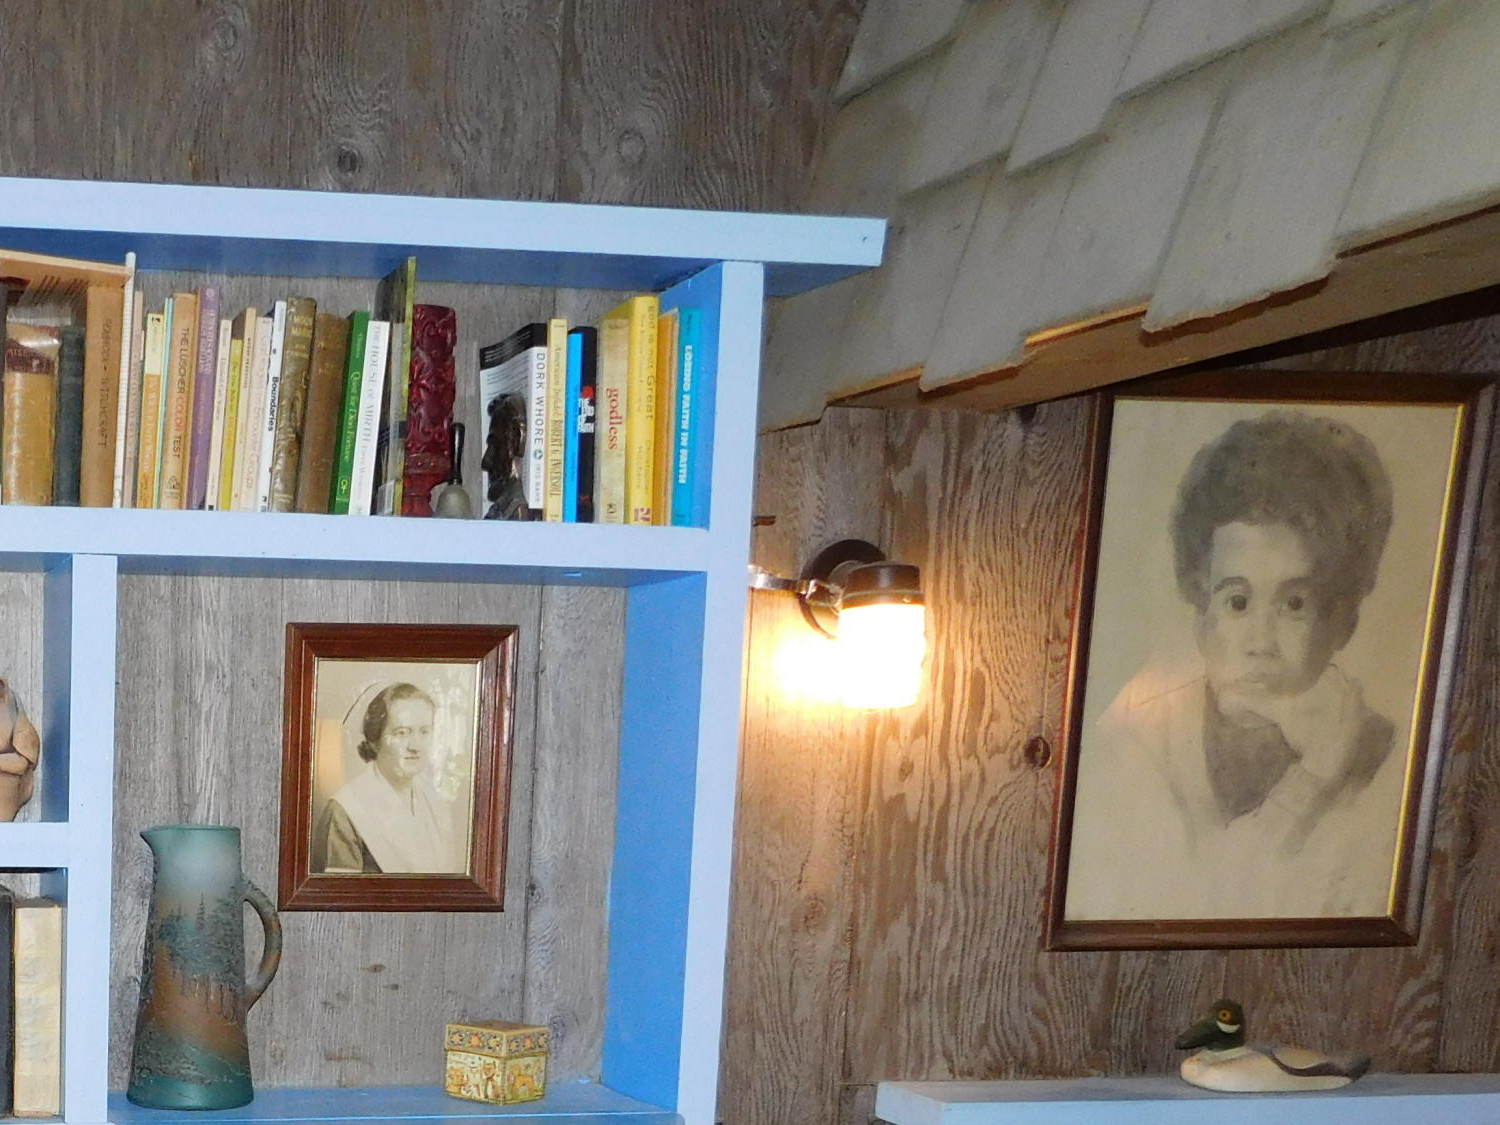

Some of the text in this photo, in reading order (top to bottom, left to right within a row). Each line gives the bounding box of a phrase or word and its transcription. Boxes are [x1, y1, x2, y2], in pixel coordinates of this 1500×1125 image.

[683, 345, 692, 392] LOSING
[173, 327, 189, 458] THE COLOR TEST
[268, 376, 279, 432] Boundaries
[534, 353, 545, 445] DORK WHORE
[646, 375, 656, 421] Great
[681, 394, 692, 429] FAITH
[363, 403, 375, 442] MIRTH
[606, 387, 622, 450] godless
[680, 432, 689, 447] IN
[678, 449, 689, 484] FAITH
